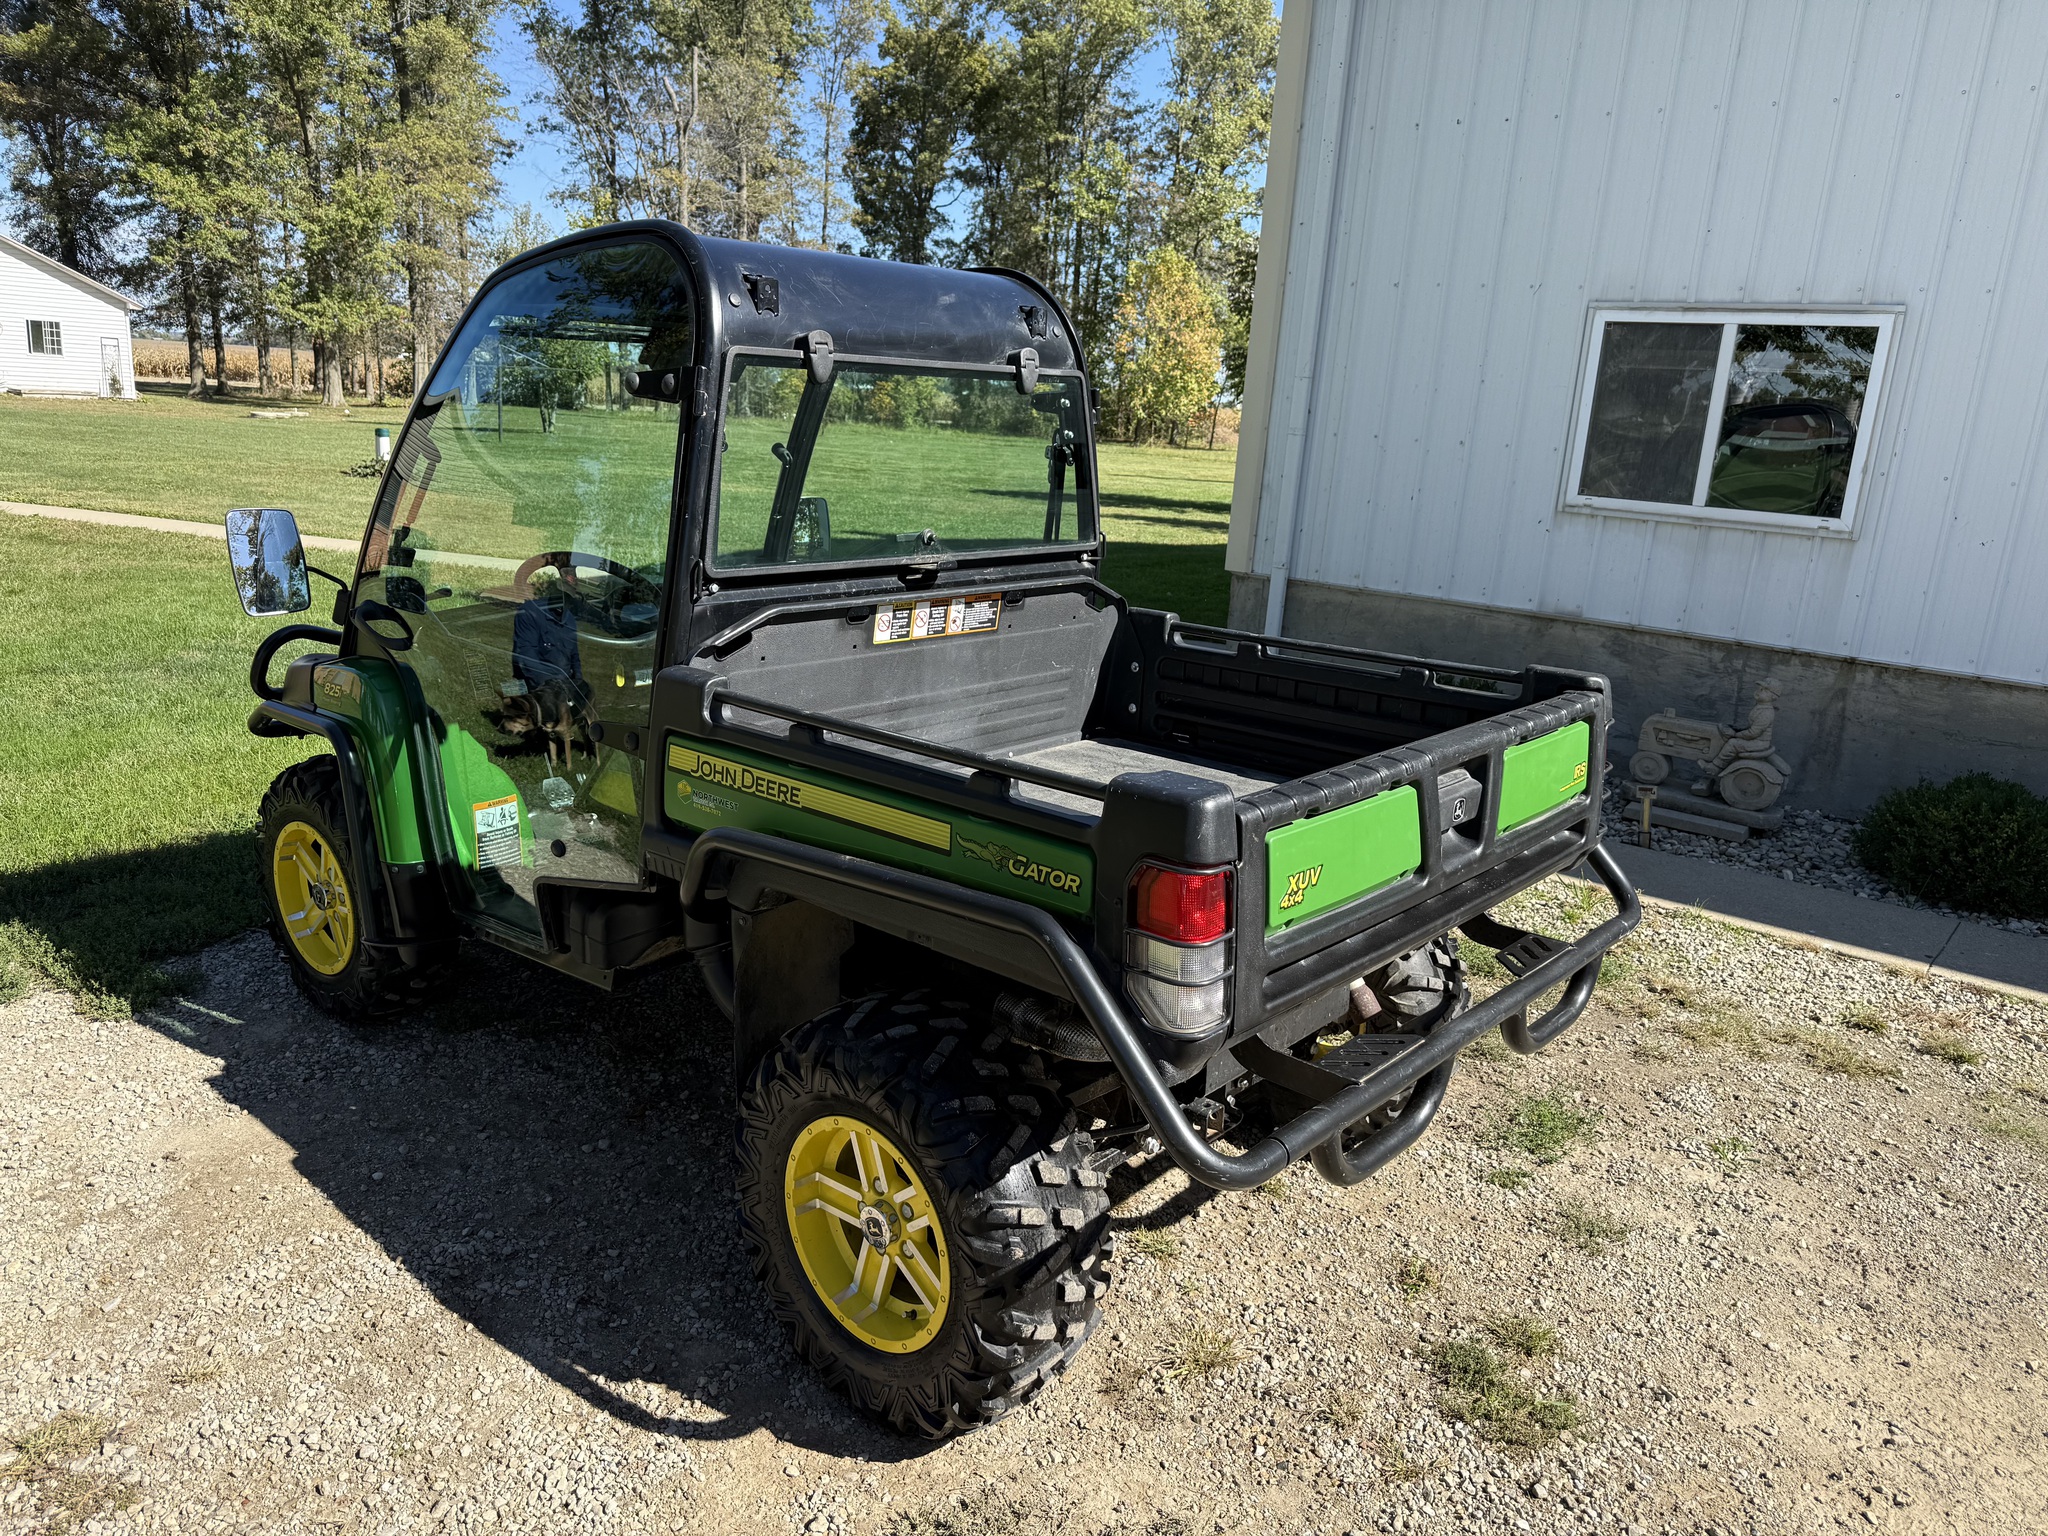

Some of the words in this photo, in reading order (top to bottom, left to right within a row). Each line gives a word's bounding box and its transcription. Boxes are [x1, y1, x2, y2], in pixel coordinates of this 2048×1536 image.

[690, 755, 738, 788] JOHN
[741, 768, 802, 807] DEERE
[692, 788, 739, 811] NORTHWEST
[1008, 855, 1082, 895] GATOR
[1286, 864, 1323, 895] XUV
[1280, 889, 1304, 909] 4x4
